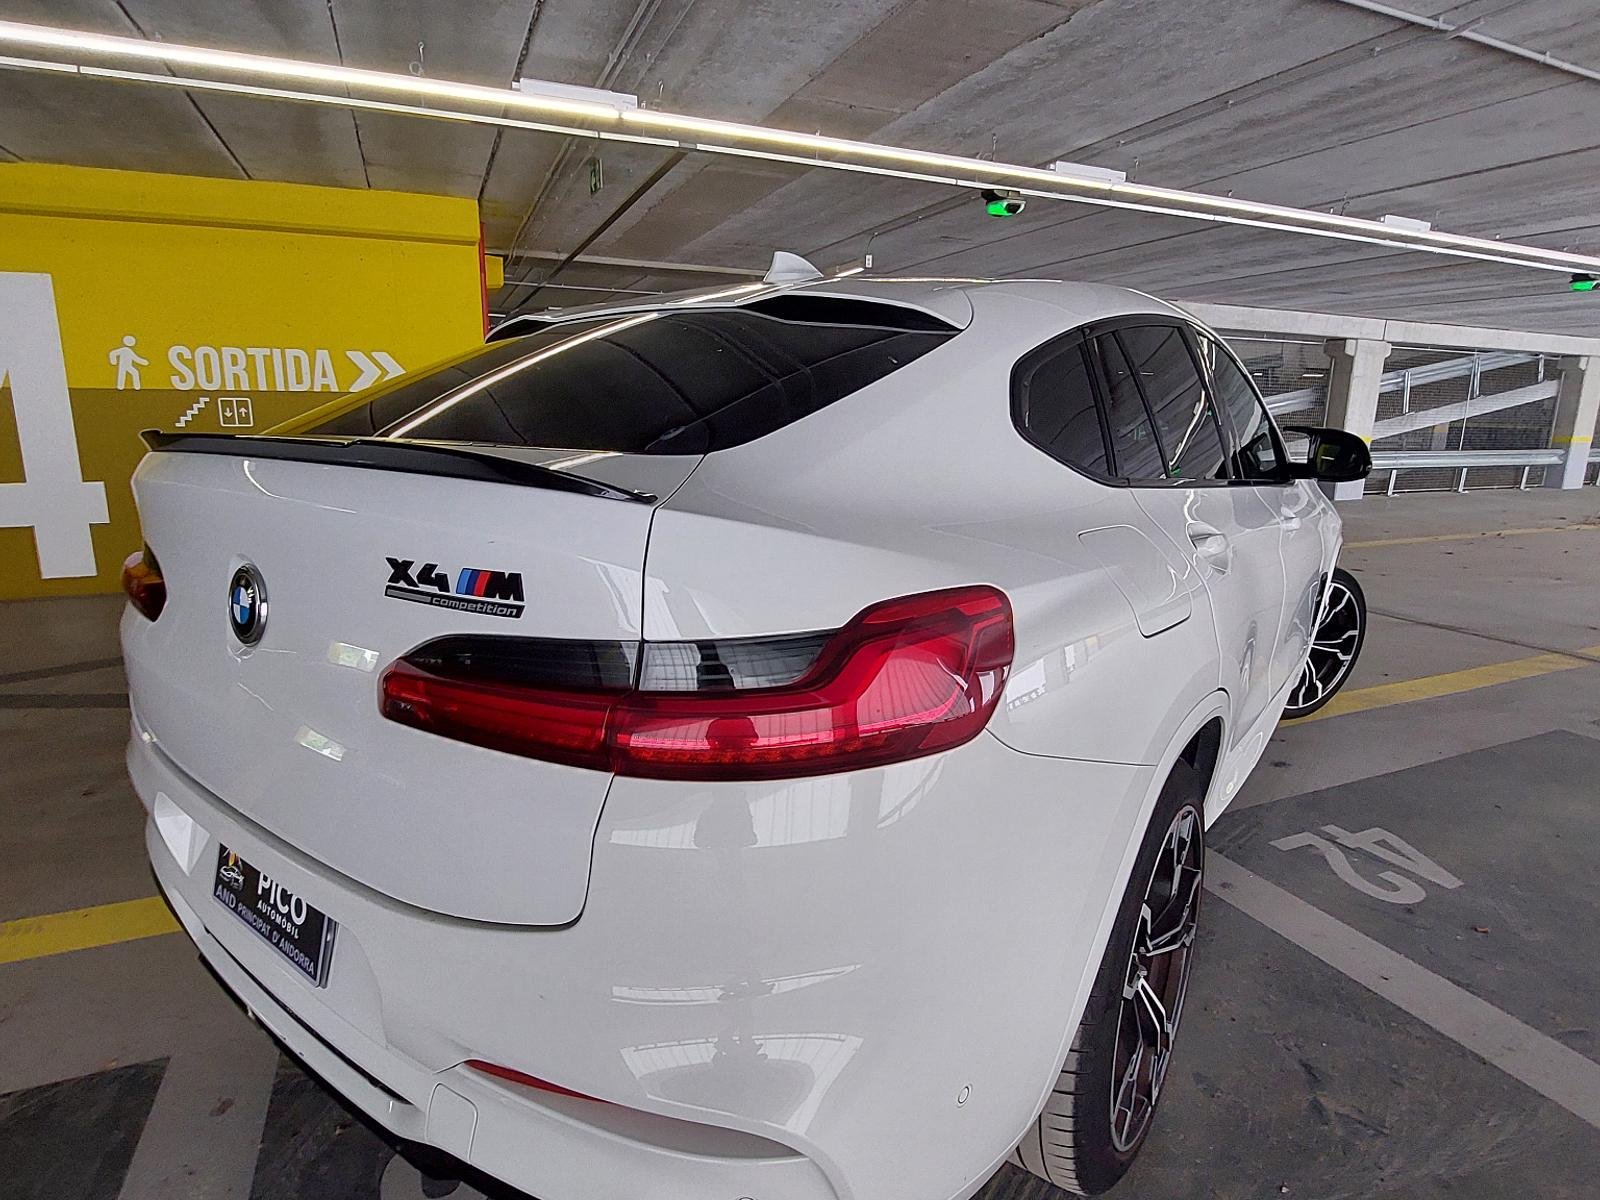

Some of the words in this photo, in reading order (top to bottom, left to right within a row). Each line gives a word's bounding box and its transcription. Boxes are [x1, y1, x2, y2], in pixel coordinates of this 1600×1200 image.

[168, 345, 339, 392] SORTIDA
[385, 557, 450, 593] X4
[480, 570, 525, 602] M
[432, 597, 517, 616] competition
[1268, 824, 1464, 904] 42
[215, 884, 237, 909] AND
[237, 902, 271, 937] PRINCIPAT
[257, 872, 307, 925] PICO
